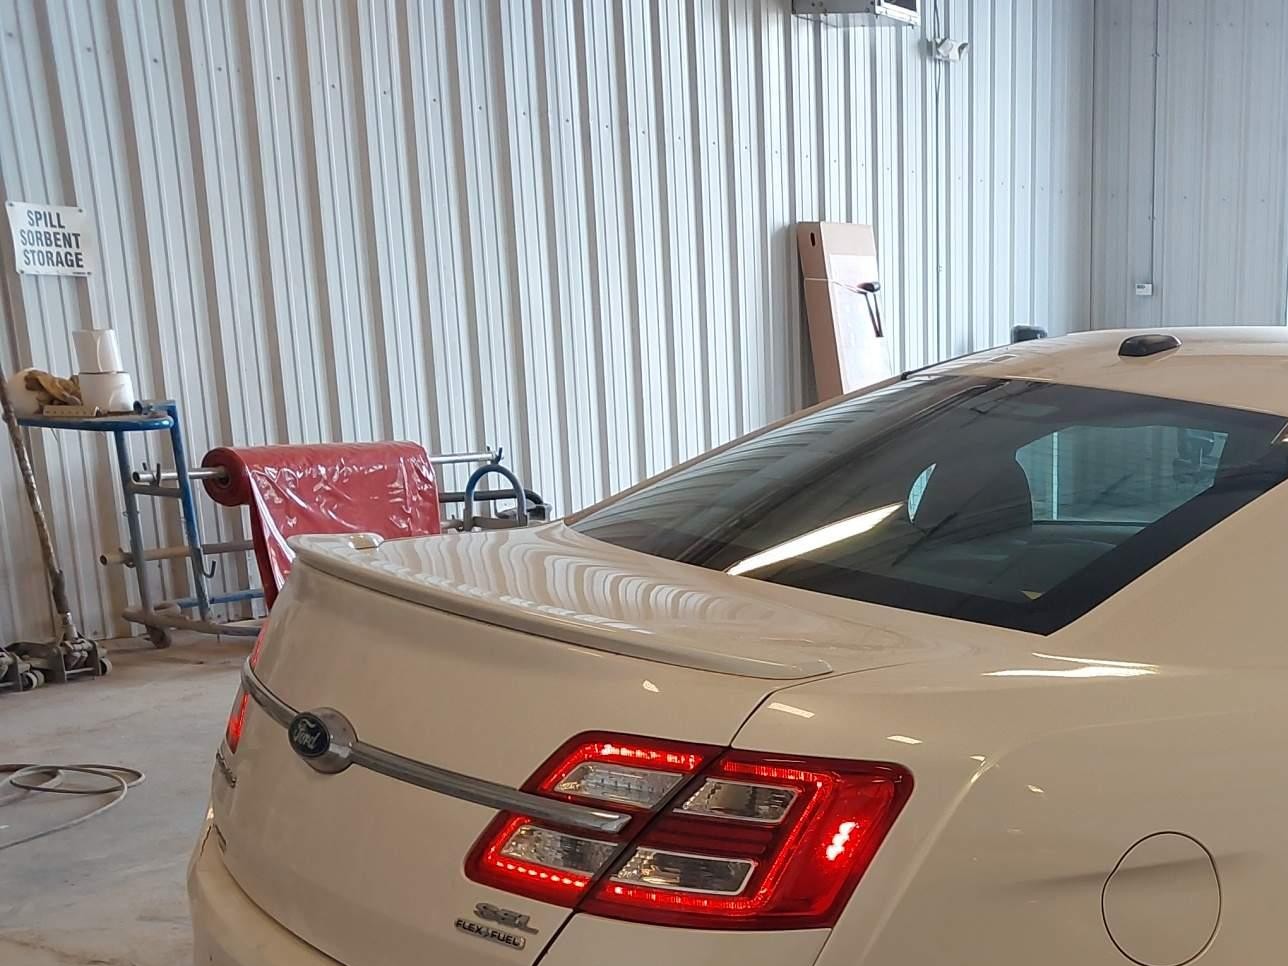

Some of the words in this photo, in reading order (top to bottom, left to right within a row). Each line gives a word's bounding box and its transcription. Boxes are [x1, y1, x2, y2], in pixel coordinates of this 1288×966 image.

[27, 210, 65, 229] SPILL
[20, 229, 81, 249] SORBENT
[23, 249, 84, 268] STORAGE
[473, 902, 540, 935] SEL
[455, 918, 483, 936] FLEX
[490, 930, 521, 947] FUEL
